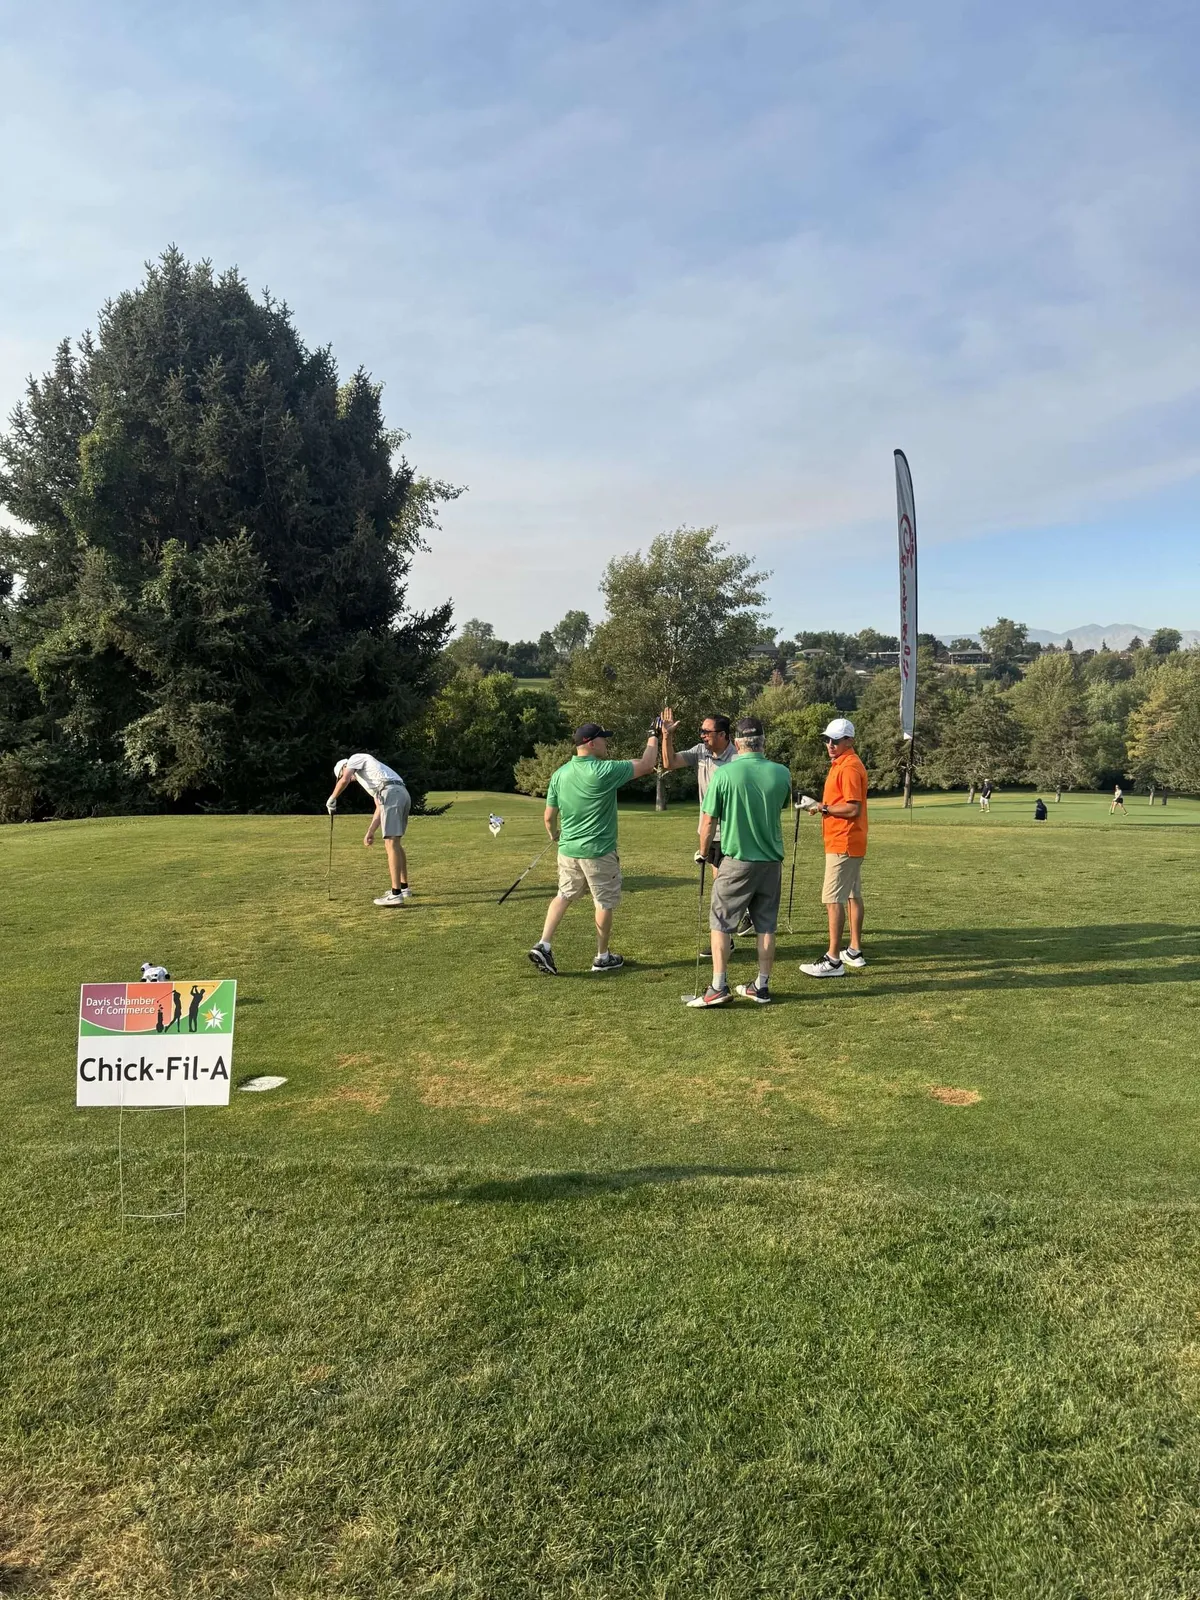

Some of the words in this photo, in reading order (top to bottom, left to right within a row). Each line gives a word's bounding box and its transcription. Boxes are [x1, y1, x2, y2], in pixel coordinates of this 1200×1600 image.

[86, 997, 111, 1006] Davis
[113, 997, 155, 1006] Chamber
[94, 1006, 104, 1015] of
[106, 1006, 155, 1015] Commerce
[79, 1056, 229, 1082] Chick-Fil-A
